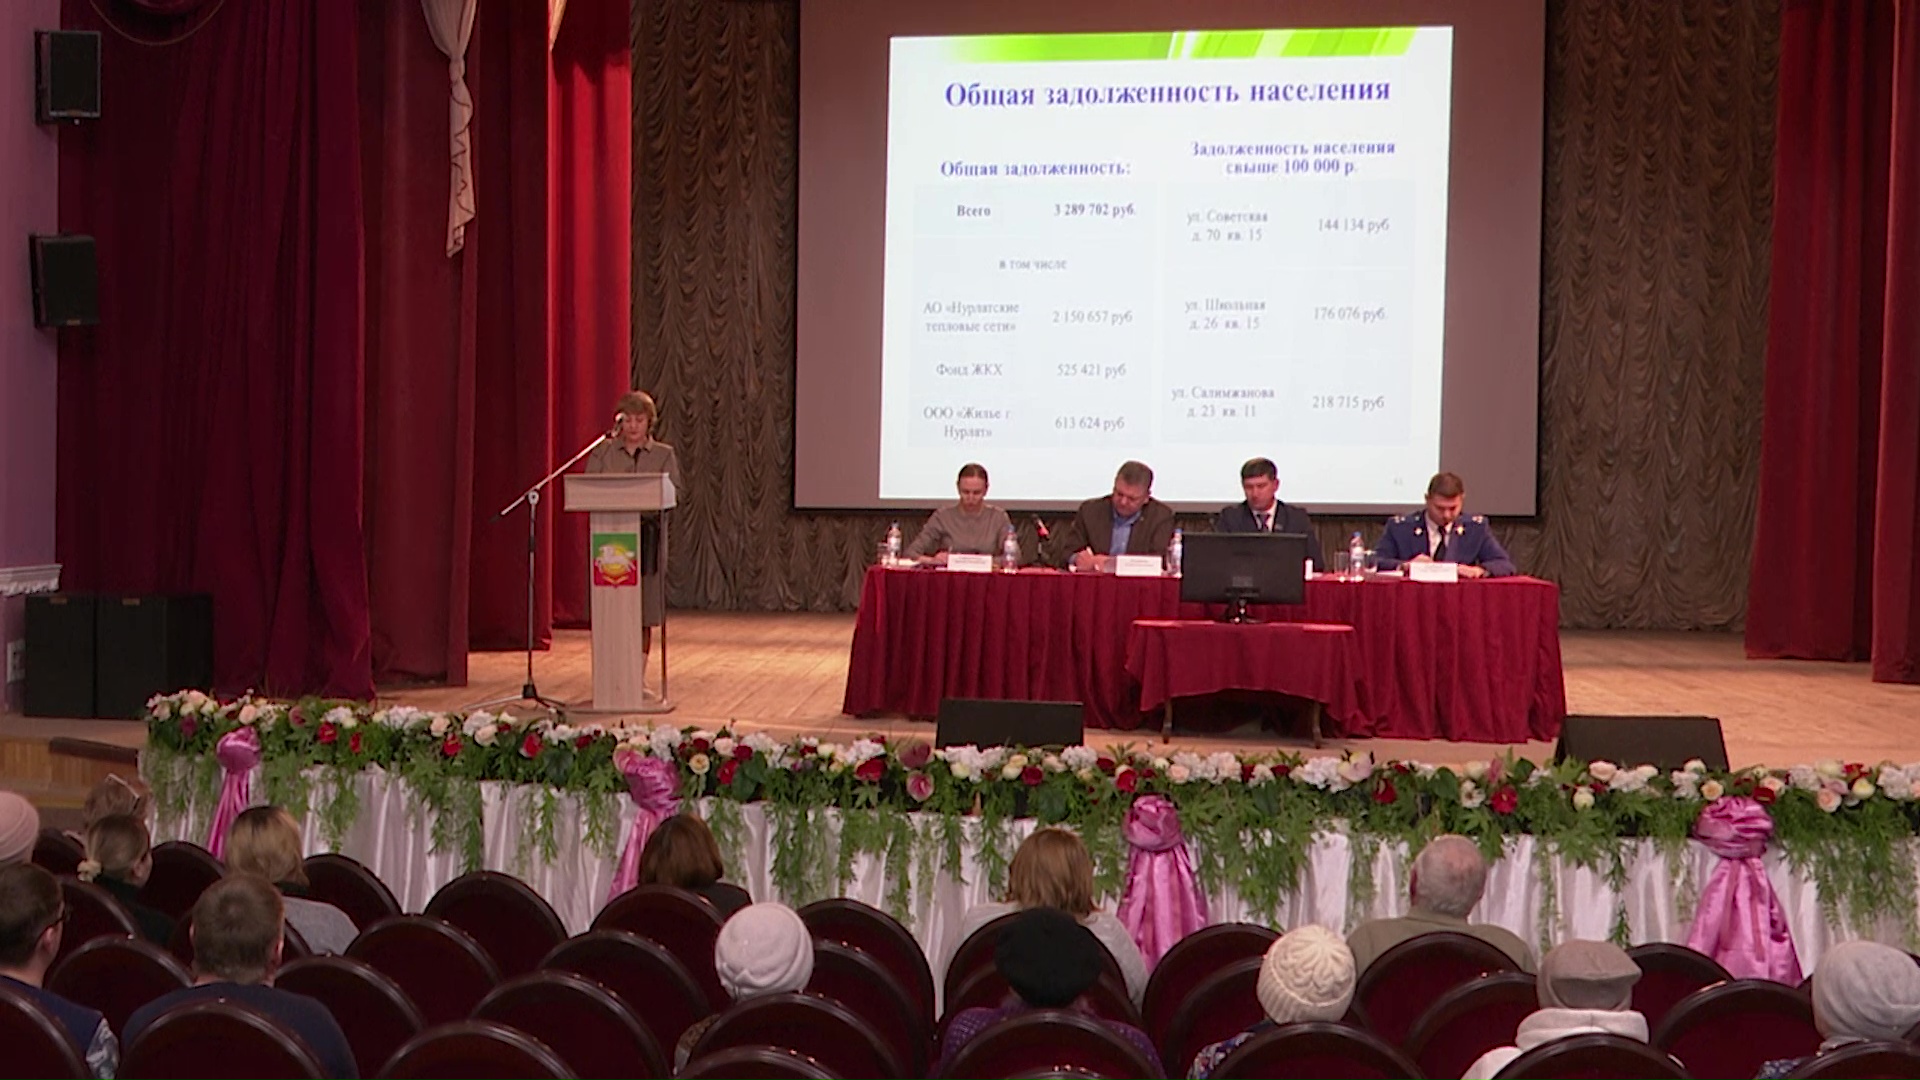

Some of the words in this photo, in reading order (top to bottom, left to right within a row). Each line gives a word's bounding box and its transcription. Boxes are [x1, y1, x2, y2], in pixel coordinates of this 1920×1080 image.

[945, 81, 1034, 109] Общая
[1047, 81, 1239, 108] задолженность
[1250, 81, 1390, 102] населения
[1192, 141, 1308, 157] Задолженность
[1314, 141, 1395, 155] населения
[941, 161, 998, 178] Общая
[1227, 160, 1279, 174] свыше
[1284, 160, 1308, 173] 100
[1314, 159, 1339, 173] 000
[957, 205, 991, 217] Всего
[1065, 204, 1085, 215] 289
[1090, 204, 1109, 215] 702
[1207, 210, 1268, 222] Советская
[1318, 218, 1338, 231] 144
[1344, 218, 1364, 231] 134
[1206, 230, 1220, 241] 70
[1250, 229, 1262, 241] 15
[1010, 261, 1030, 269] том
[1034, 261, 1067, 269] числе
[923, 303, 942, 313] АО
[1314, 308, 1336, 320] 176
[1339, 308, 1360, 320] 076
[1063, 311, 1084, 322] 150
[1088, 311, 1108, 322] 657
[926, 322, 980, 332] тепловые
[1204, 318, 1218, 329] 26
[1247, 318, 1259, 329] 15
[936, 364, 968, 376] Фонд
[971, 364, 1003, 375] ЖКХ
[1057, 364, 1077, 376] 525
[1081, 364, 1100, 376] 421
[1312, 396, 1334, 409] 218
[1339, 396, 1359, 409] 715
[923, 407, 953, 419] ООО
[1201, 406, 1216, 417] 23
[1244, 405, 1256, 417] 11
[1055, 417, 1076, 429] 613
[1079, 417, 1100, 429] 624
